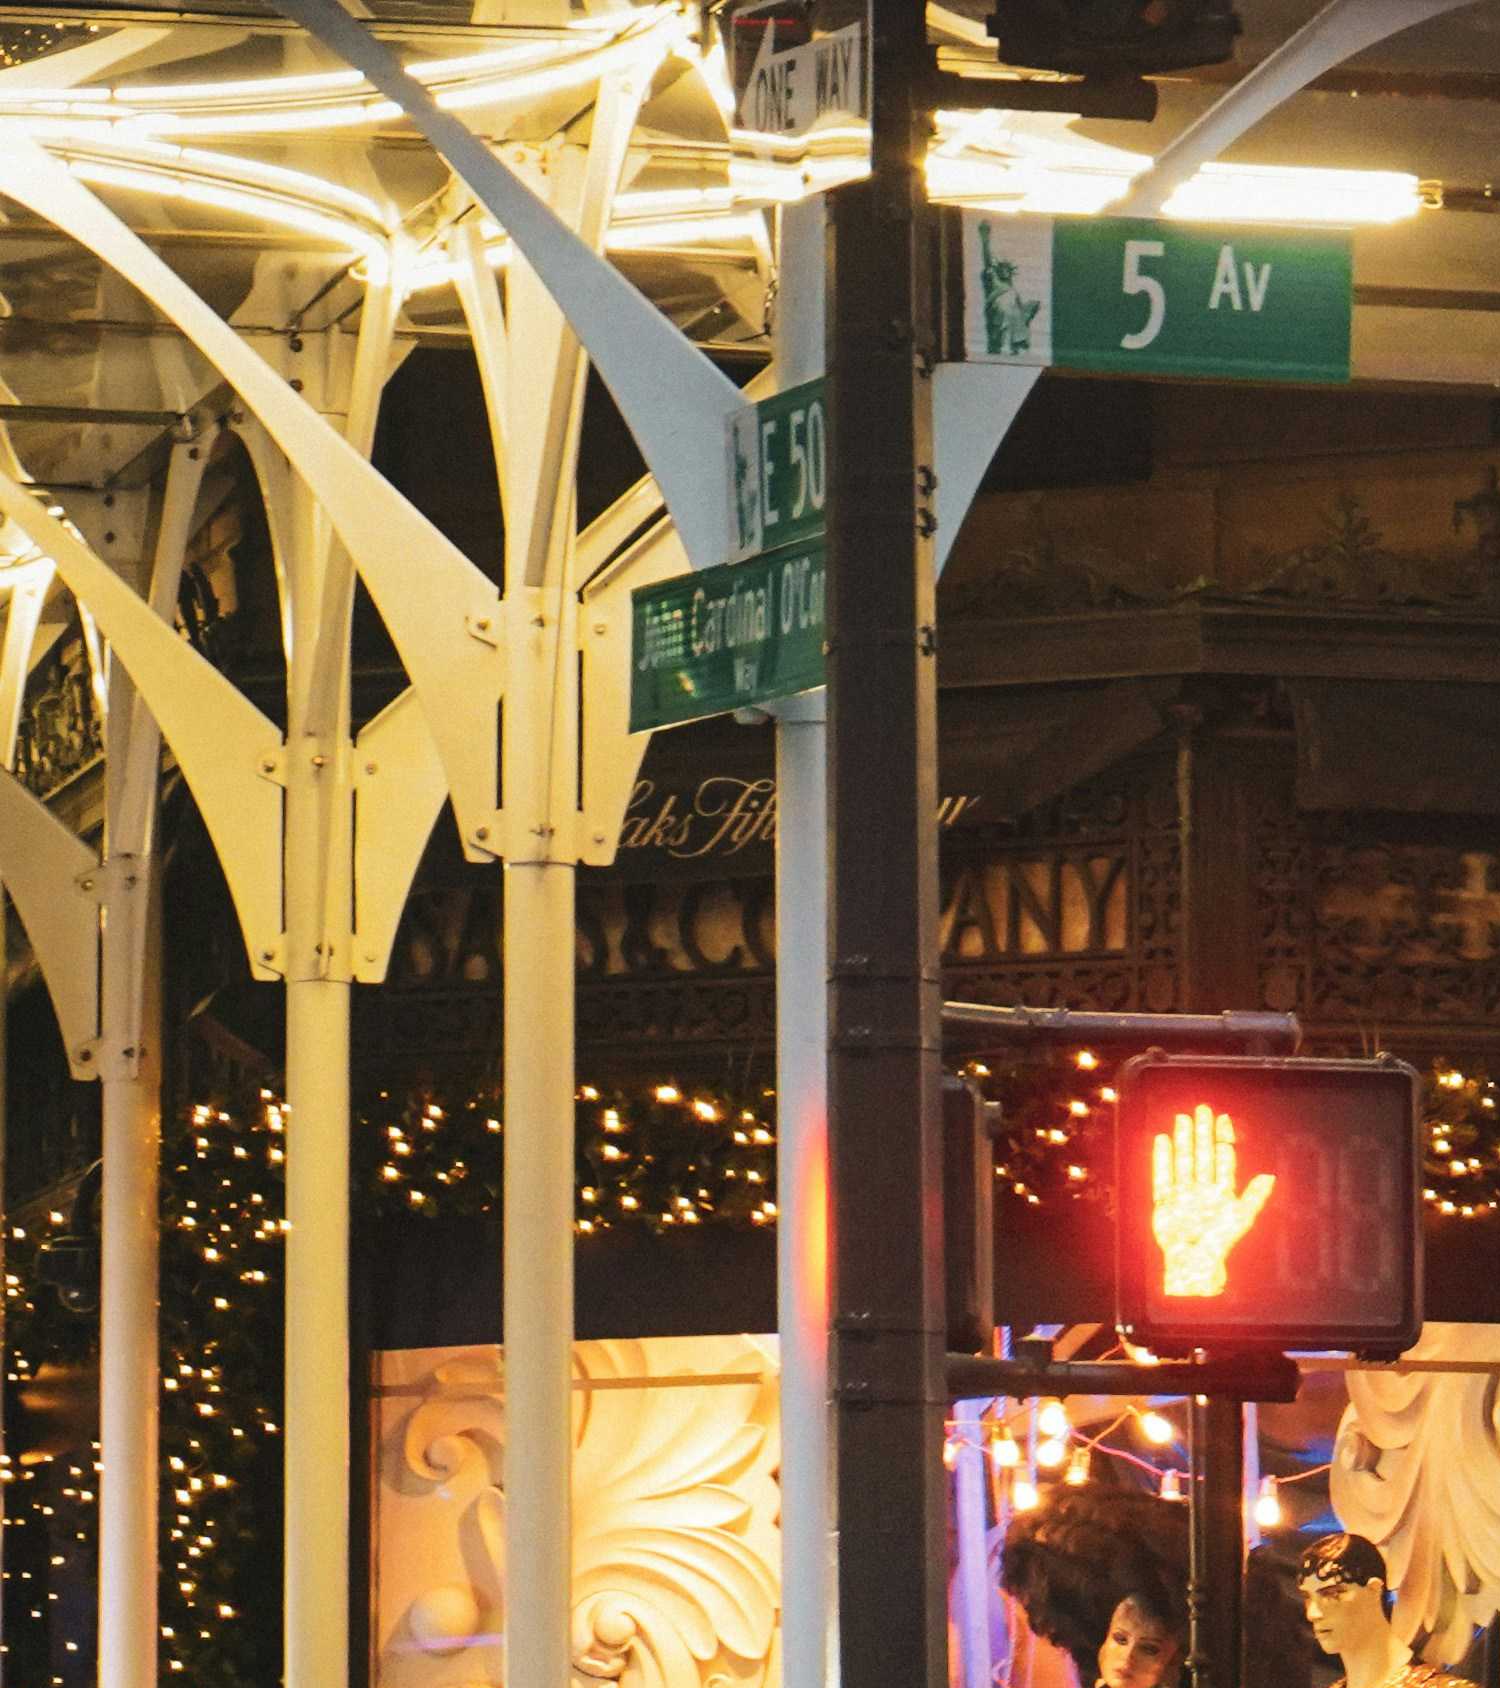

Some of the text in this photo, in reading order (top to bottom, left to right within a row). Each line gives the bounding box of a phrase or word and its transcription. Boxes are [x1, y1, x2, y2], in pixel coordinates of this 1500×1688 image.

[755, 38, 853, 133] ONE WAY
[1119, 239, 1272, 350] 5 Av
[761, 401, 826, 527] E 50
[691, 570, 773, 656] Cardinal
[668, 776, 776, 859] Fif
